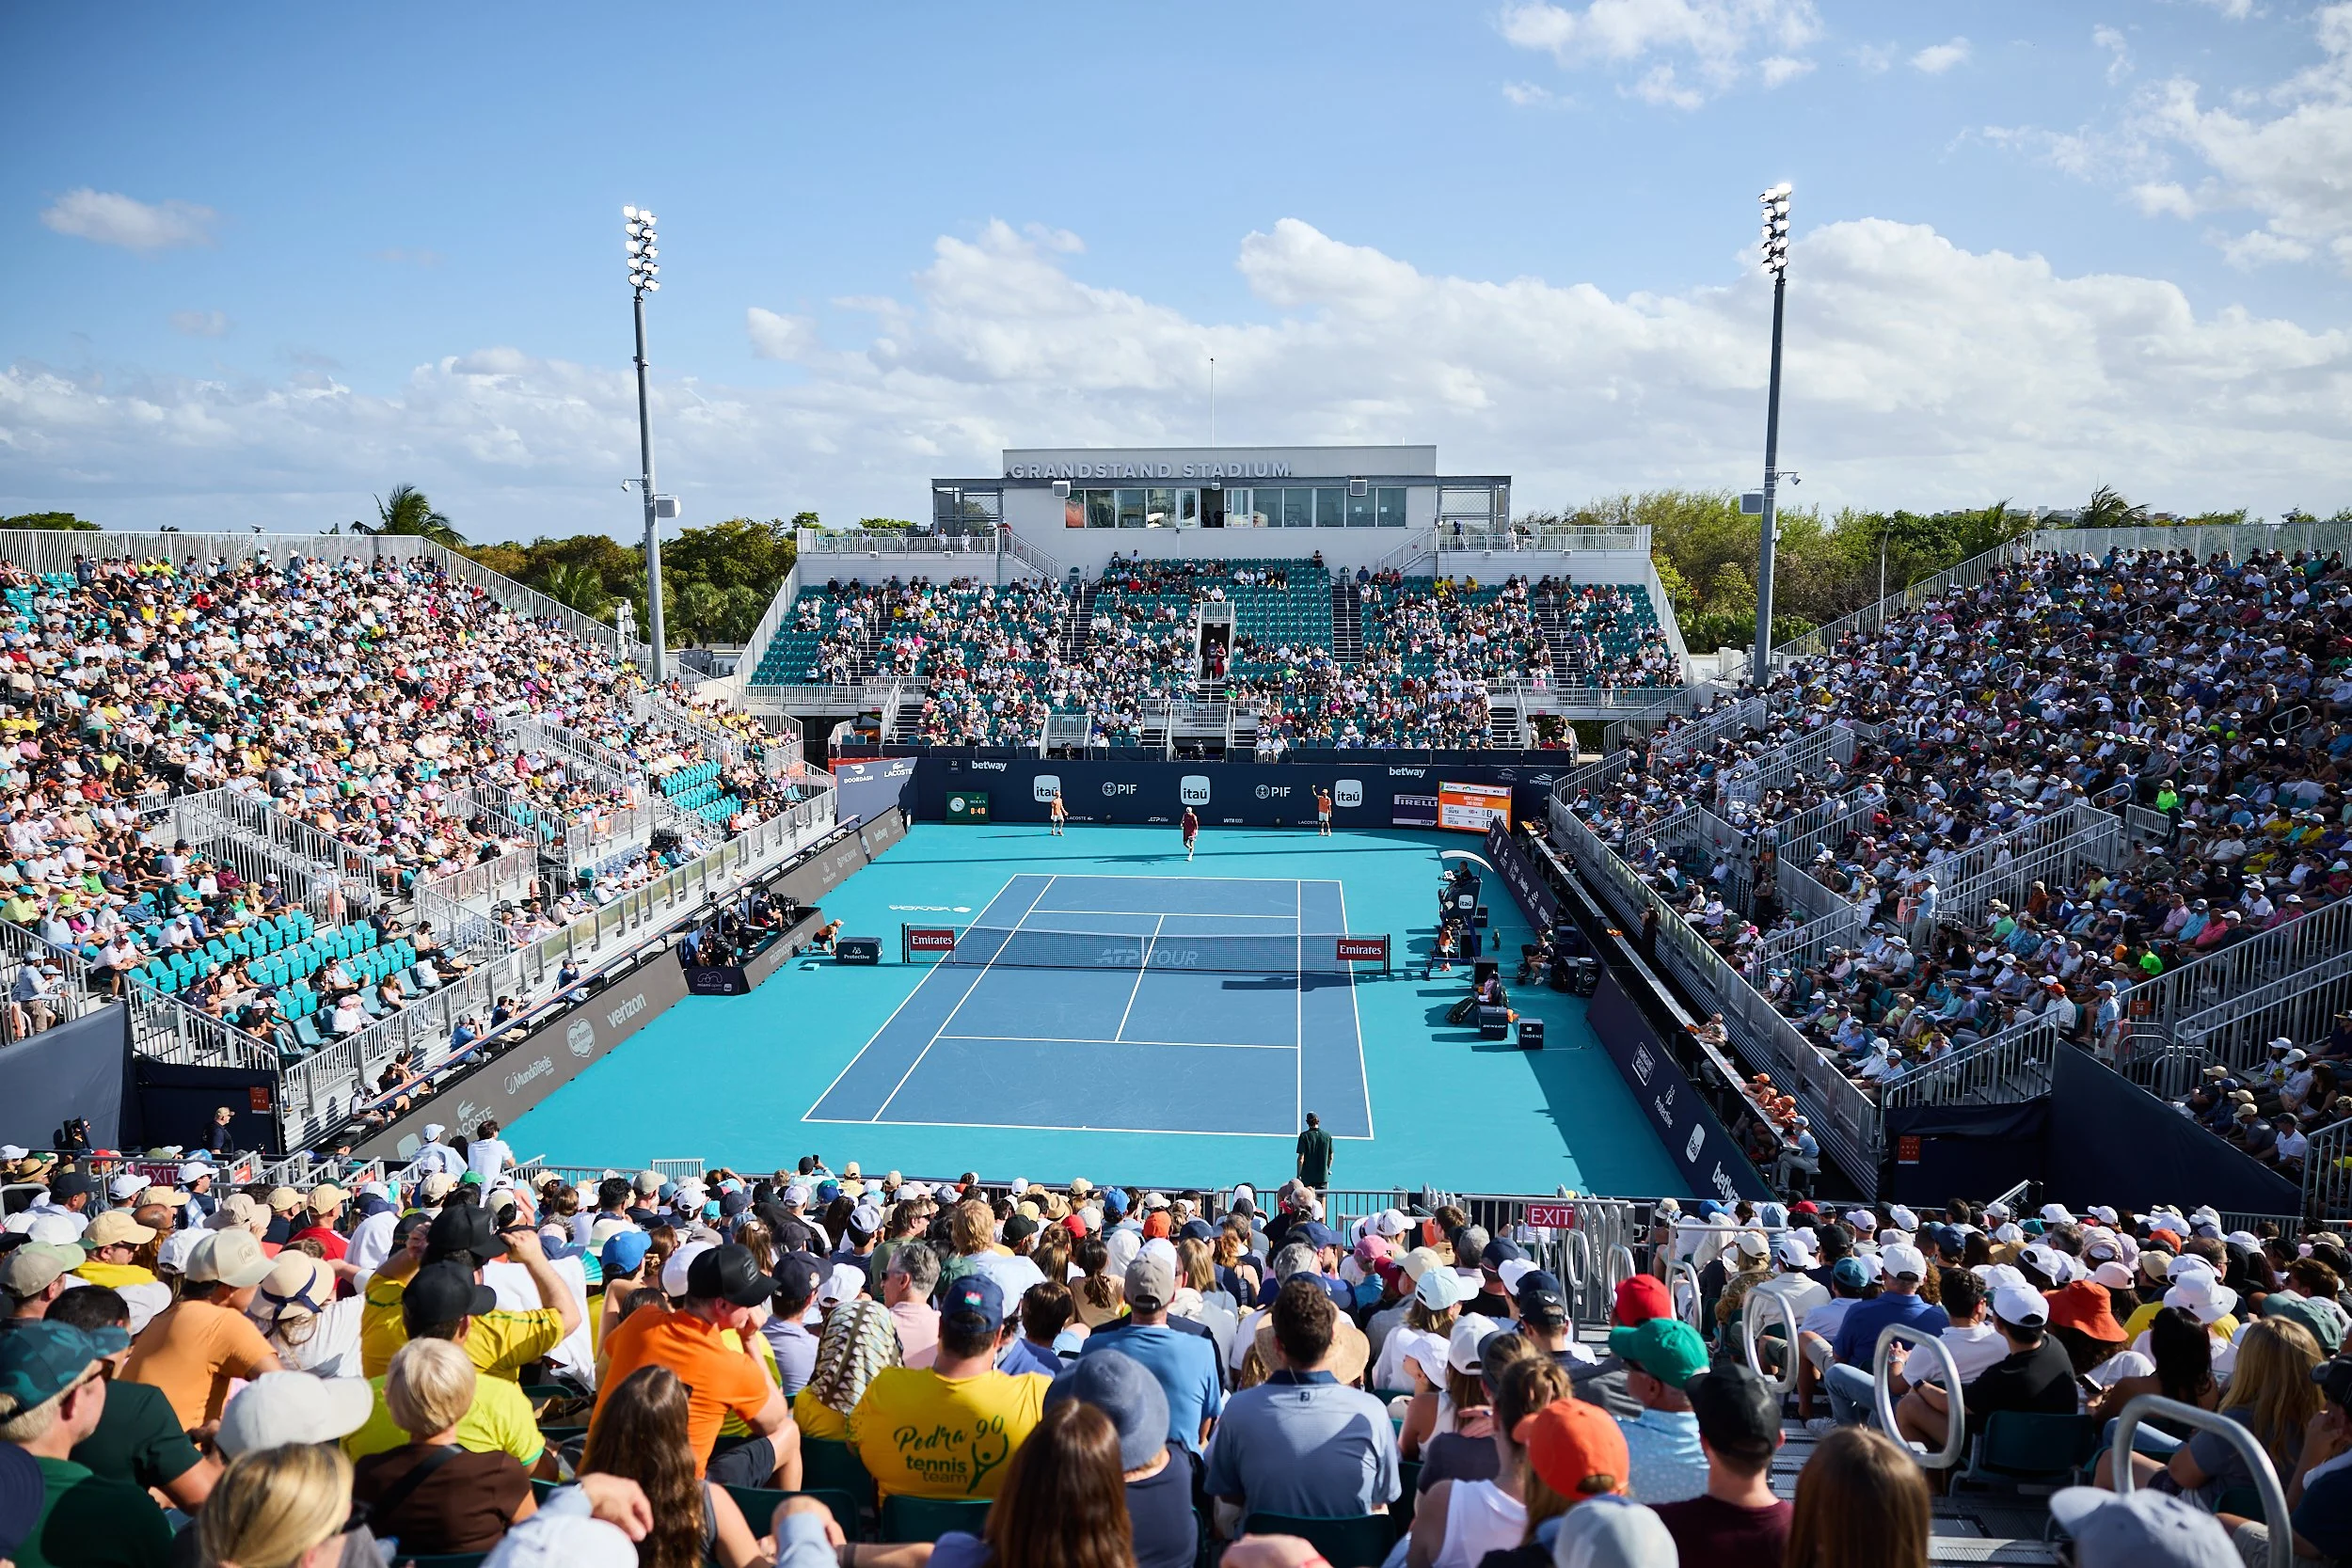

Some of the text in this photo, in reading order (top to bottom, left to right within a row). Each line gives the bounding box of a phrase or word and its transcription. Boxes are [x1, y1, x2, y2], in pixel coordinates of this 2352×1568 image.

[1009, 462, 1292, 480] GRANDSTAND STADIUM
[971, 760, 1008, 772] betway
[843, 774, 874, 784] DOORDASH
[883, 768, 914, 778] LACOSTE
[1389, 767, 1426, 779] betway
[1118, 784, 1137, 795] PIF
[1183, 787, 1208, 800] itaú
[1271, 786, 1292, 798] PIF
[1337, 790, 1360, 801] itaú
[1393, 794, 1438, 807] PIRELLI
[912, 935, 953, 946] Emirates
[1339, 944, 1382, 956] Emirates
[1094, 948, 1199, 966] ATP TOUR
[607, 992, 647, 1029] verizon
[1655, 1095, 1674, 1129] Protective
[141, 1168, 179, 1184] EXIT
[1711, 1161, 1741, 1202] betwa
[1531, 1208, 1573, 1226] EXIT
[894, 1415, 1004, 1452] Pedra 90
[906, 1454, 967, 1473] tennis
[922, 1467, 968, 1484] team
